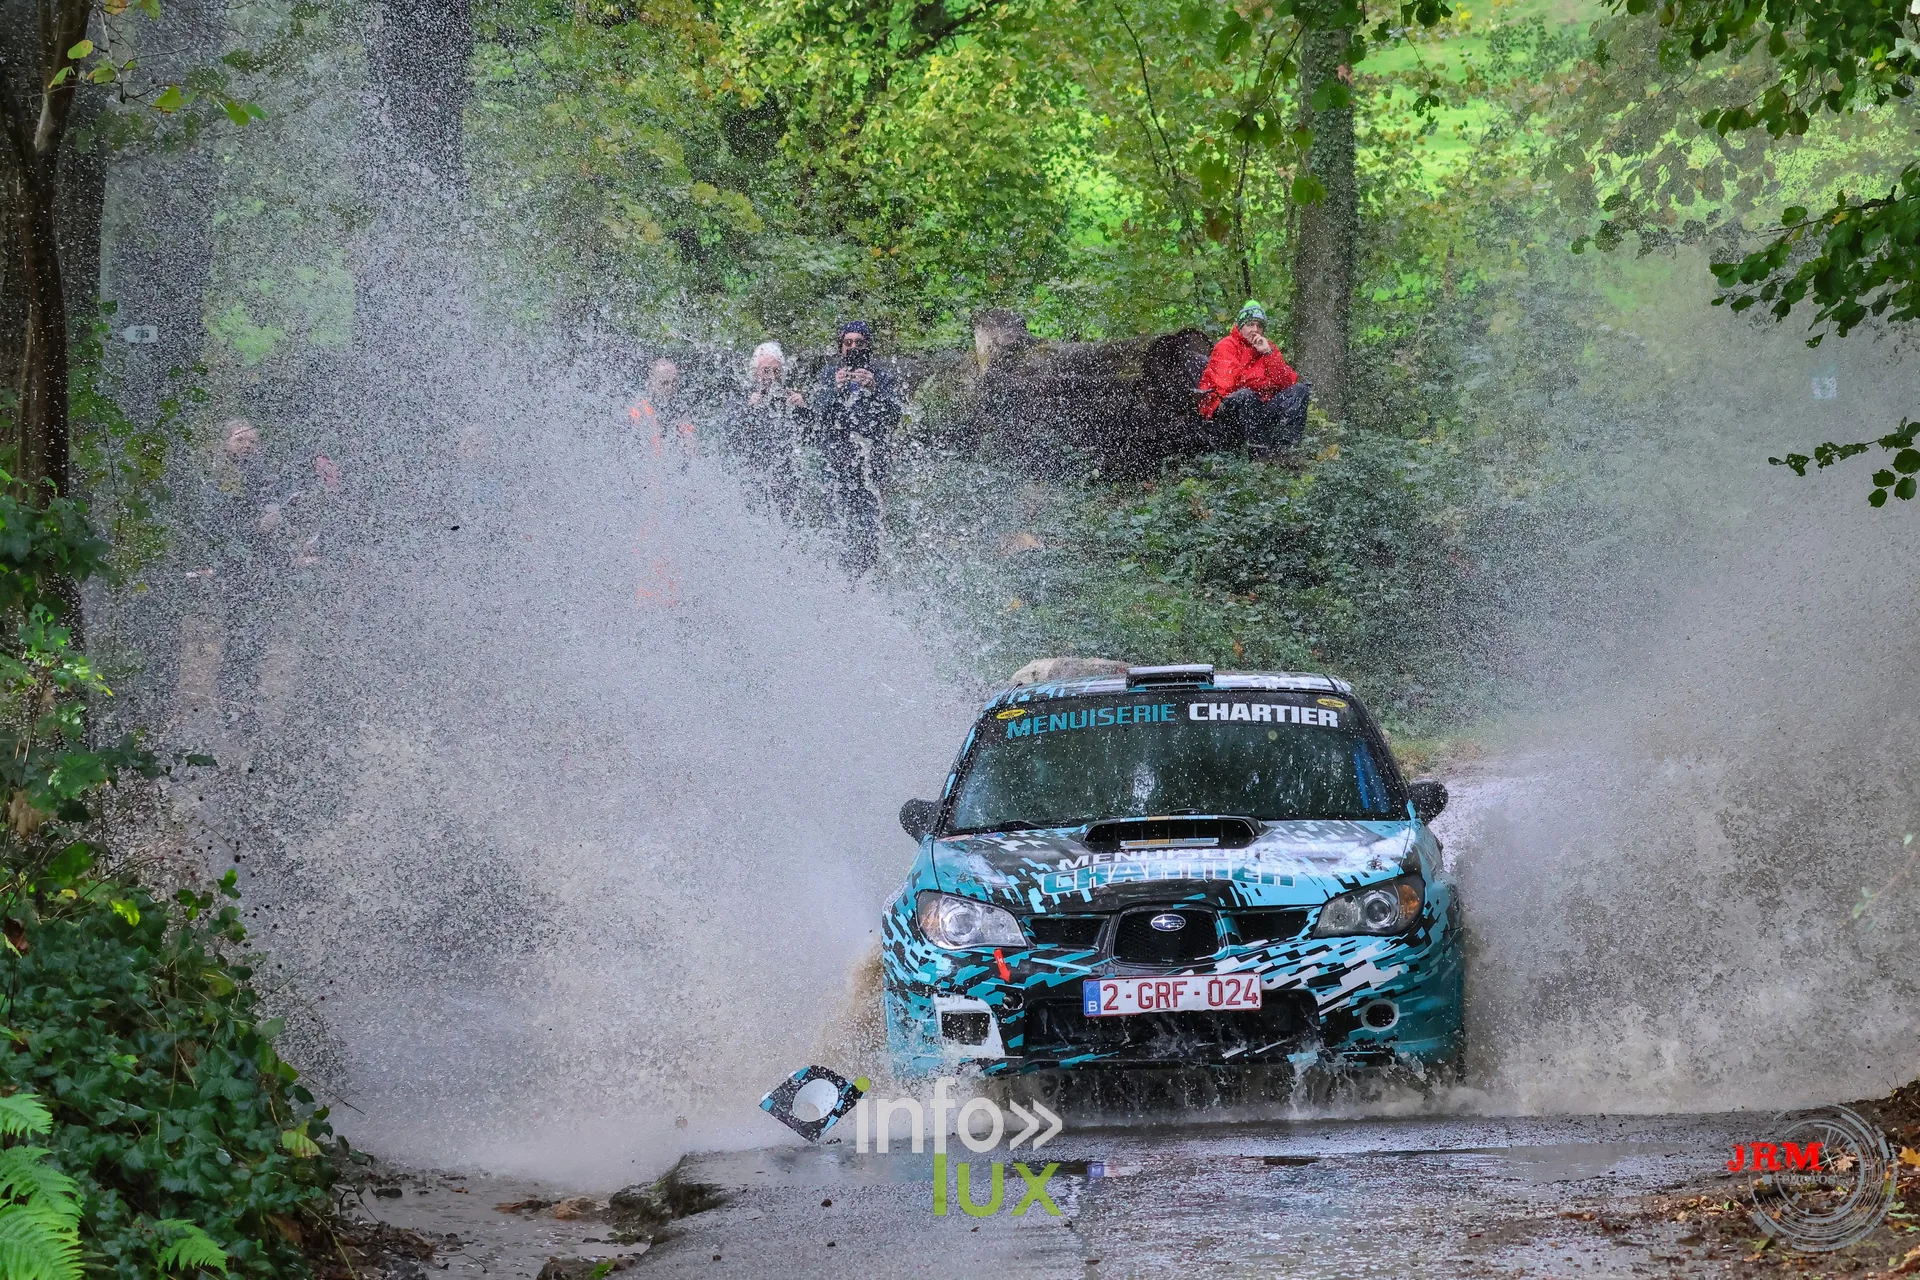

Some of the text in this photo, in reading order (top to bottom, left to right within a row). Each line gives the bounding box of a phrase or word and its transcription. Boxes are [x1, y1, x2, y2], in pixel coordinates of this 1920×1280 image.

[1007, 703, 1339, 739] MENUISERIE CHARTIER
[1088, 1001, 1098, 1012] B
